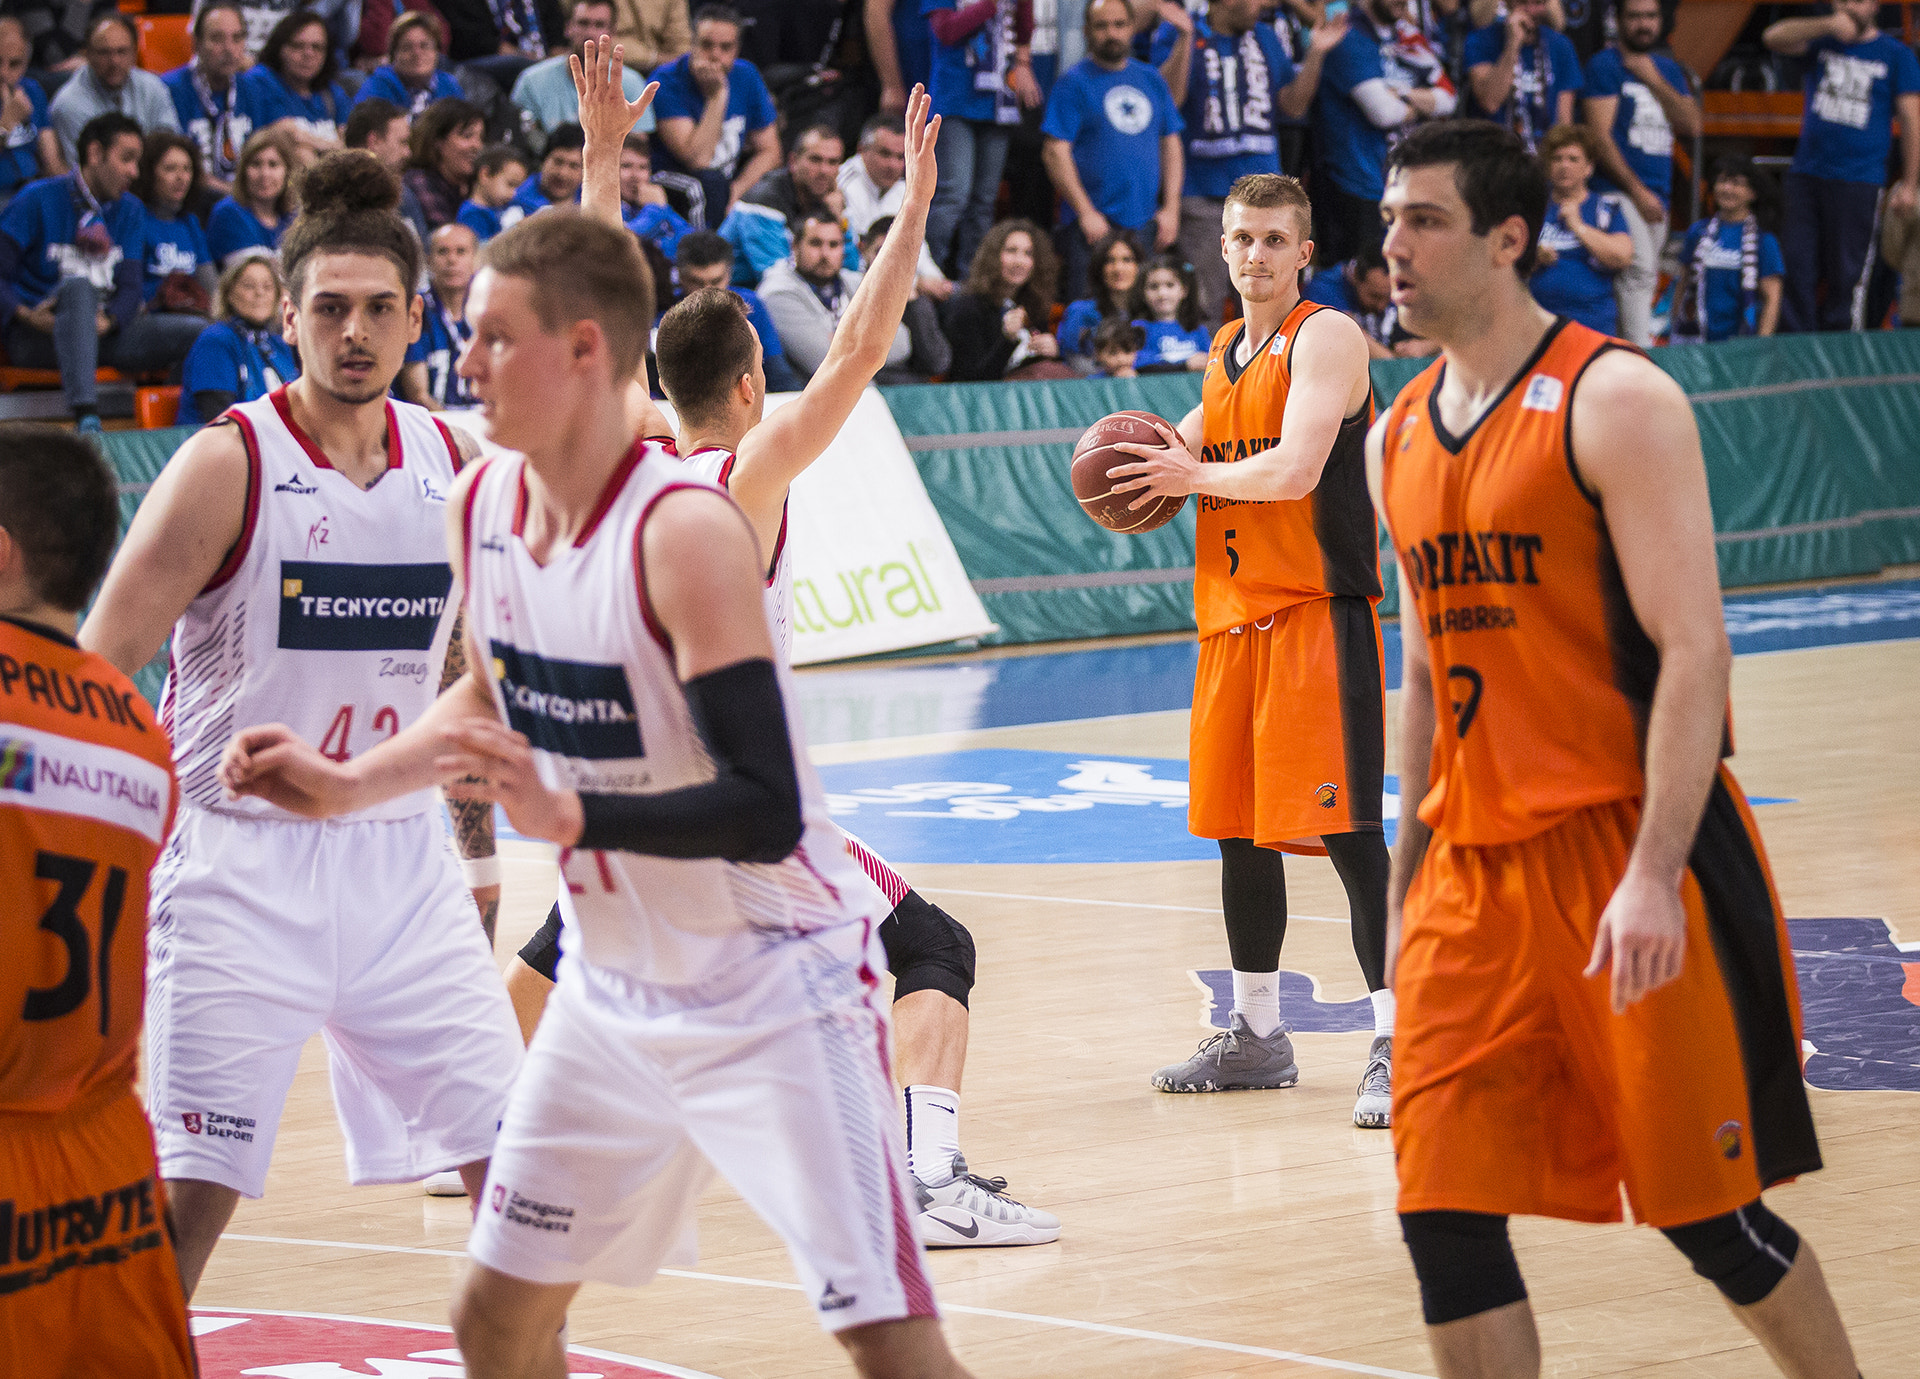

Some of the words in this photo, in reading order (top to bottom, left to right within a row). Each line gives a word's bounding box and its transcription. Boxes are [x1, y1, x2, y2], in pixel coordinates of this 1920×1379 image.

[793, 541, 942, 633] tural
[1225, 529, 1239, 577] 5
[22, 850, 128, 1037] 31
